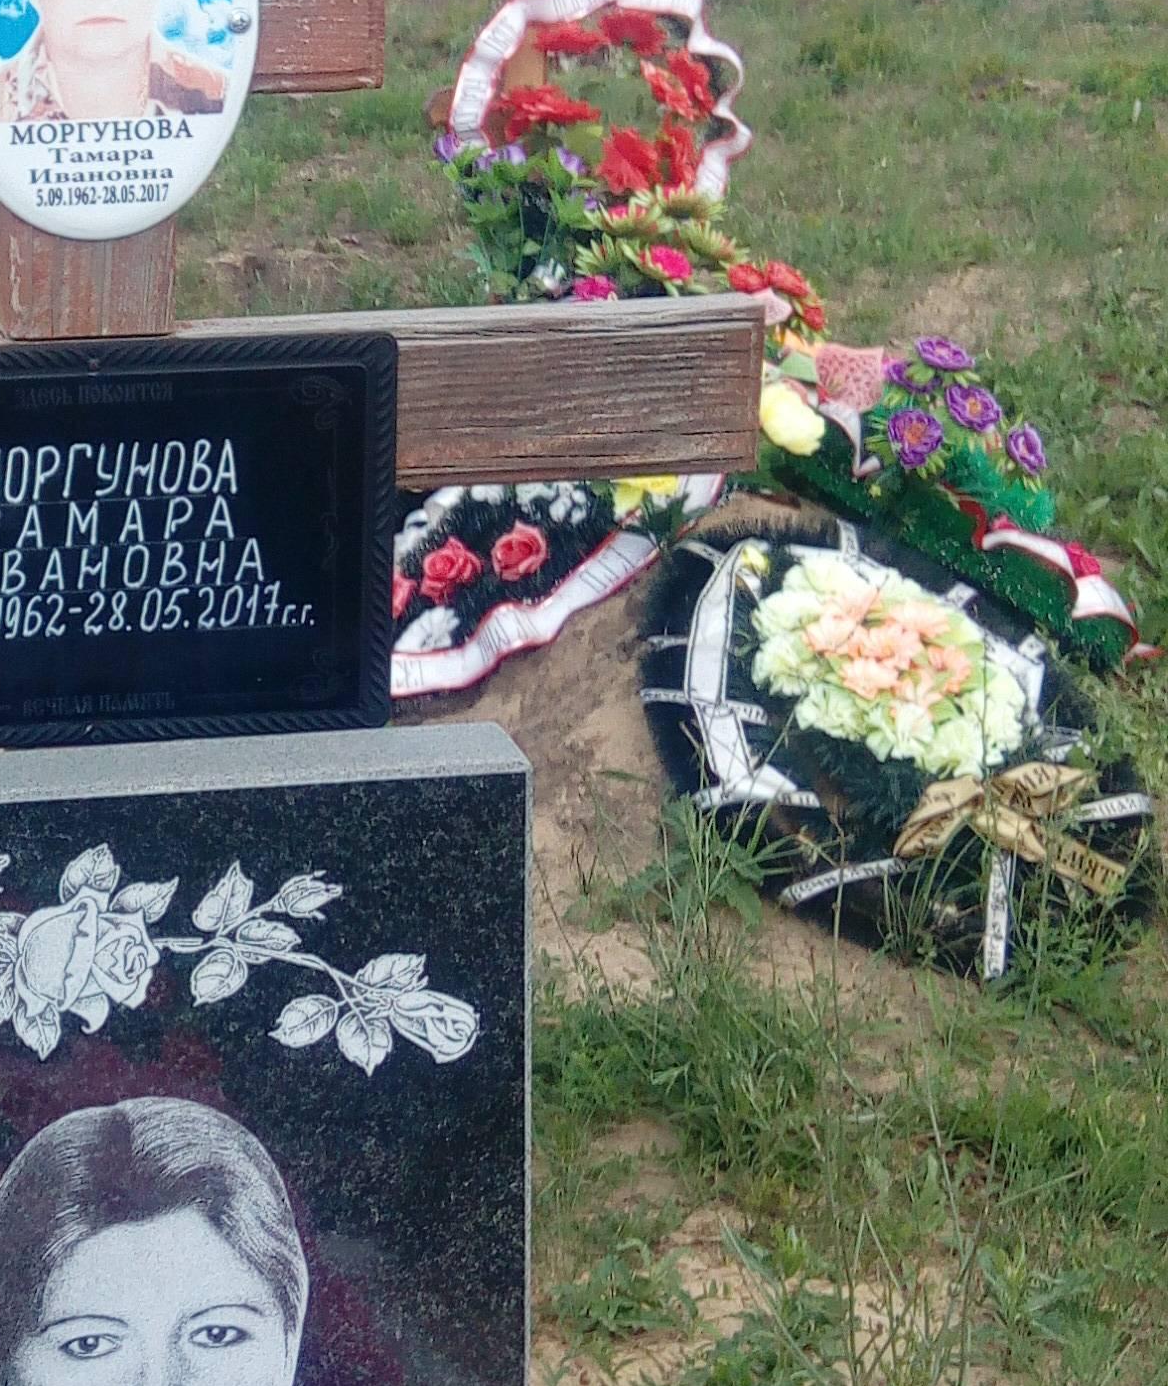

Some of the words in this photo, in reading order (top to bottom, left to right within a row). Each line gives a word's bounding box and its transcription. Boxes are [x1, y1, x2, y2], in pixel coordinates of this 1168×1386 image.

[9, 118, 193, 145] МОРГУНОВА
[48, 147, 154, 165] Тамара
[29, 167, 173, 184] Ивановна
[36, 184, 169, 207] 5.09.1962-28.05.2017
